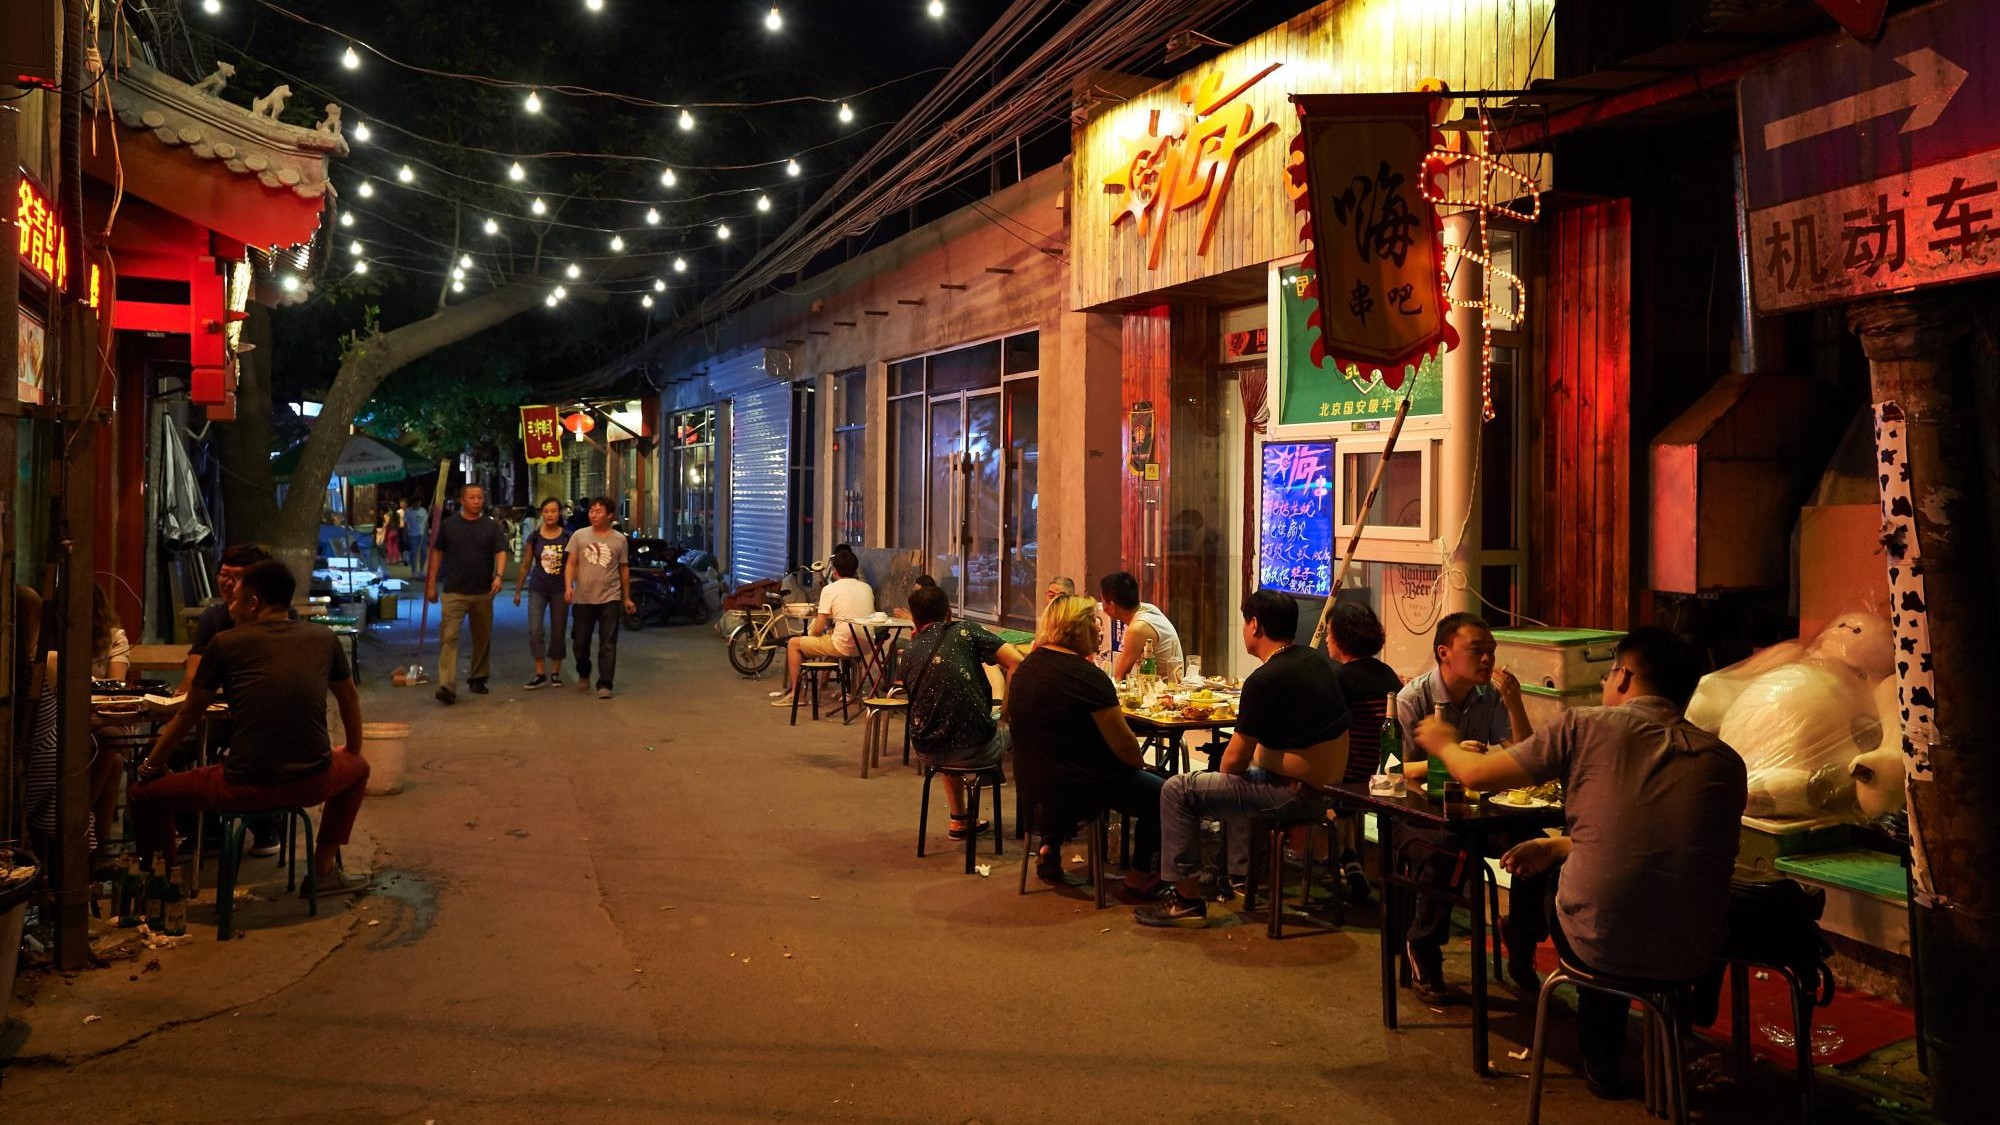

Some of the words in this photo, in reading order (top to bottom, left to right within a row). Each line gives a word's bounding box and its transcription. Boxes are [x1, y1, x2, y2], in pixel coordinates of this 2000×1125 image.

[1332, 160, 1420, 268] 嗨
[1765, 177, 2000, 294] 机动车
[1349, 280, 1422, 326] 串吧
[1400, 580, 1431, 599] Beer
